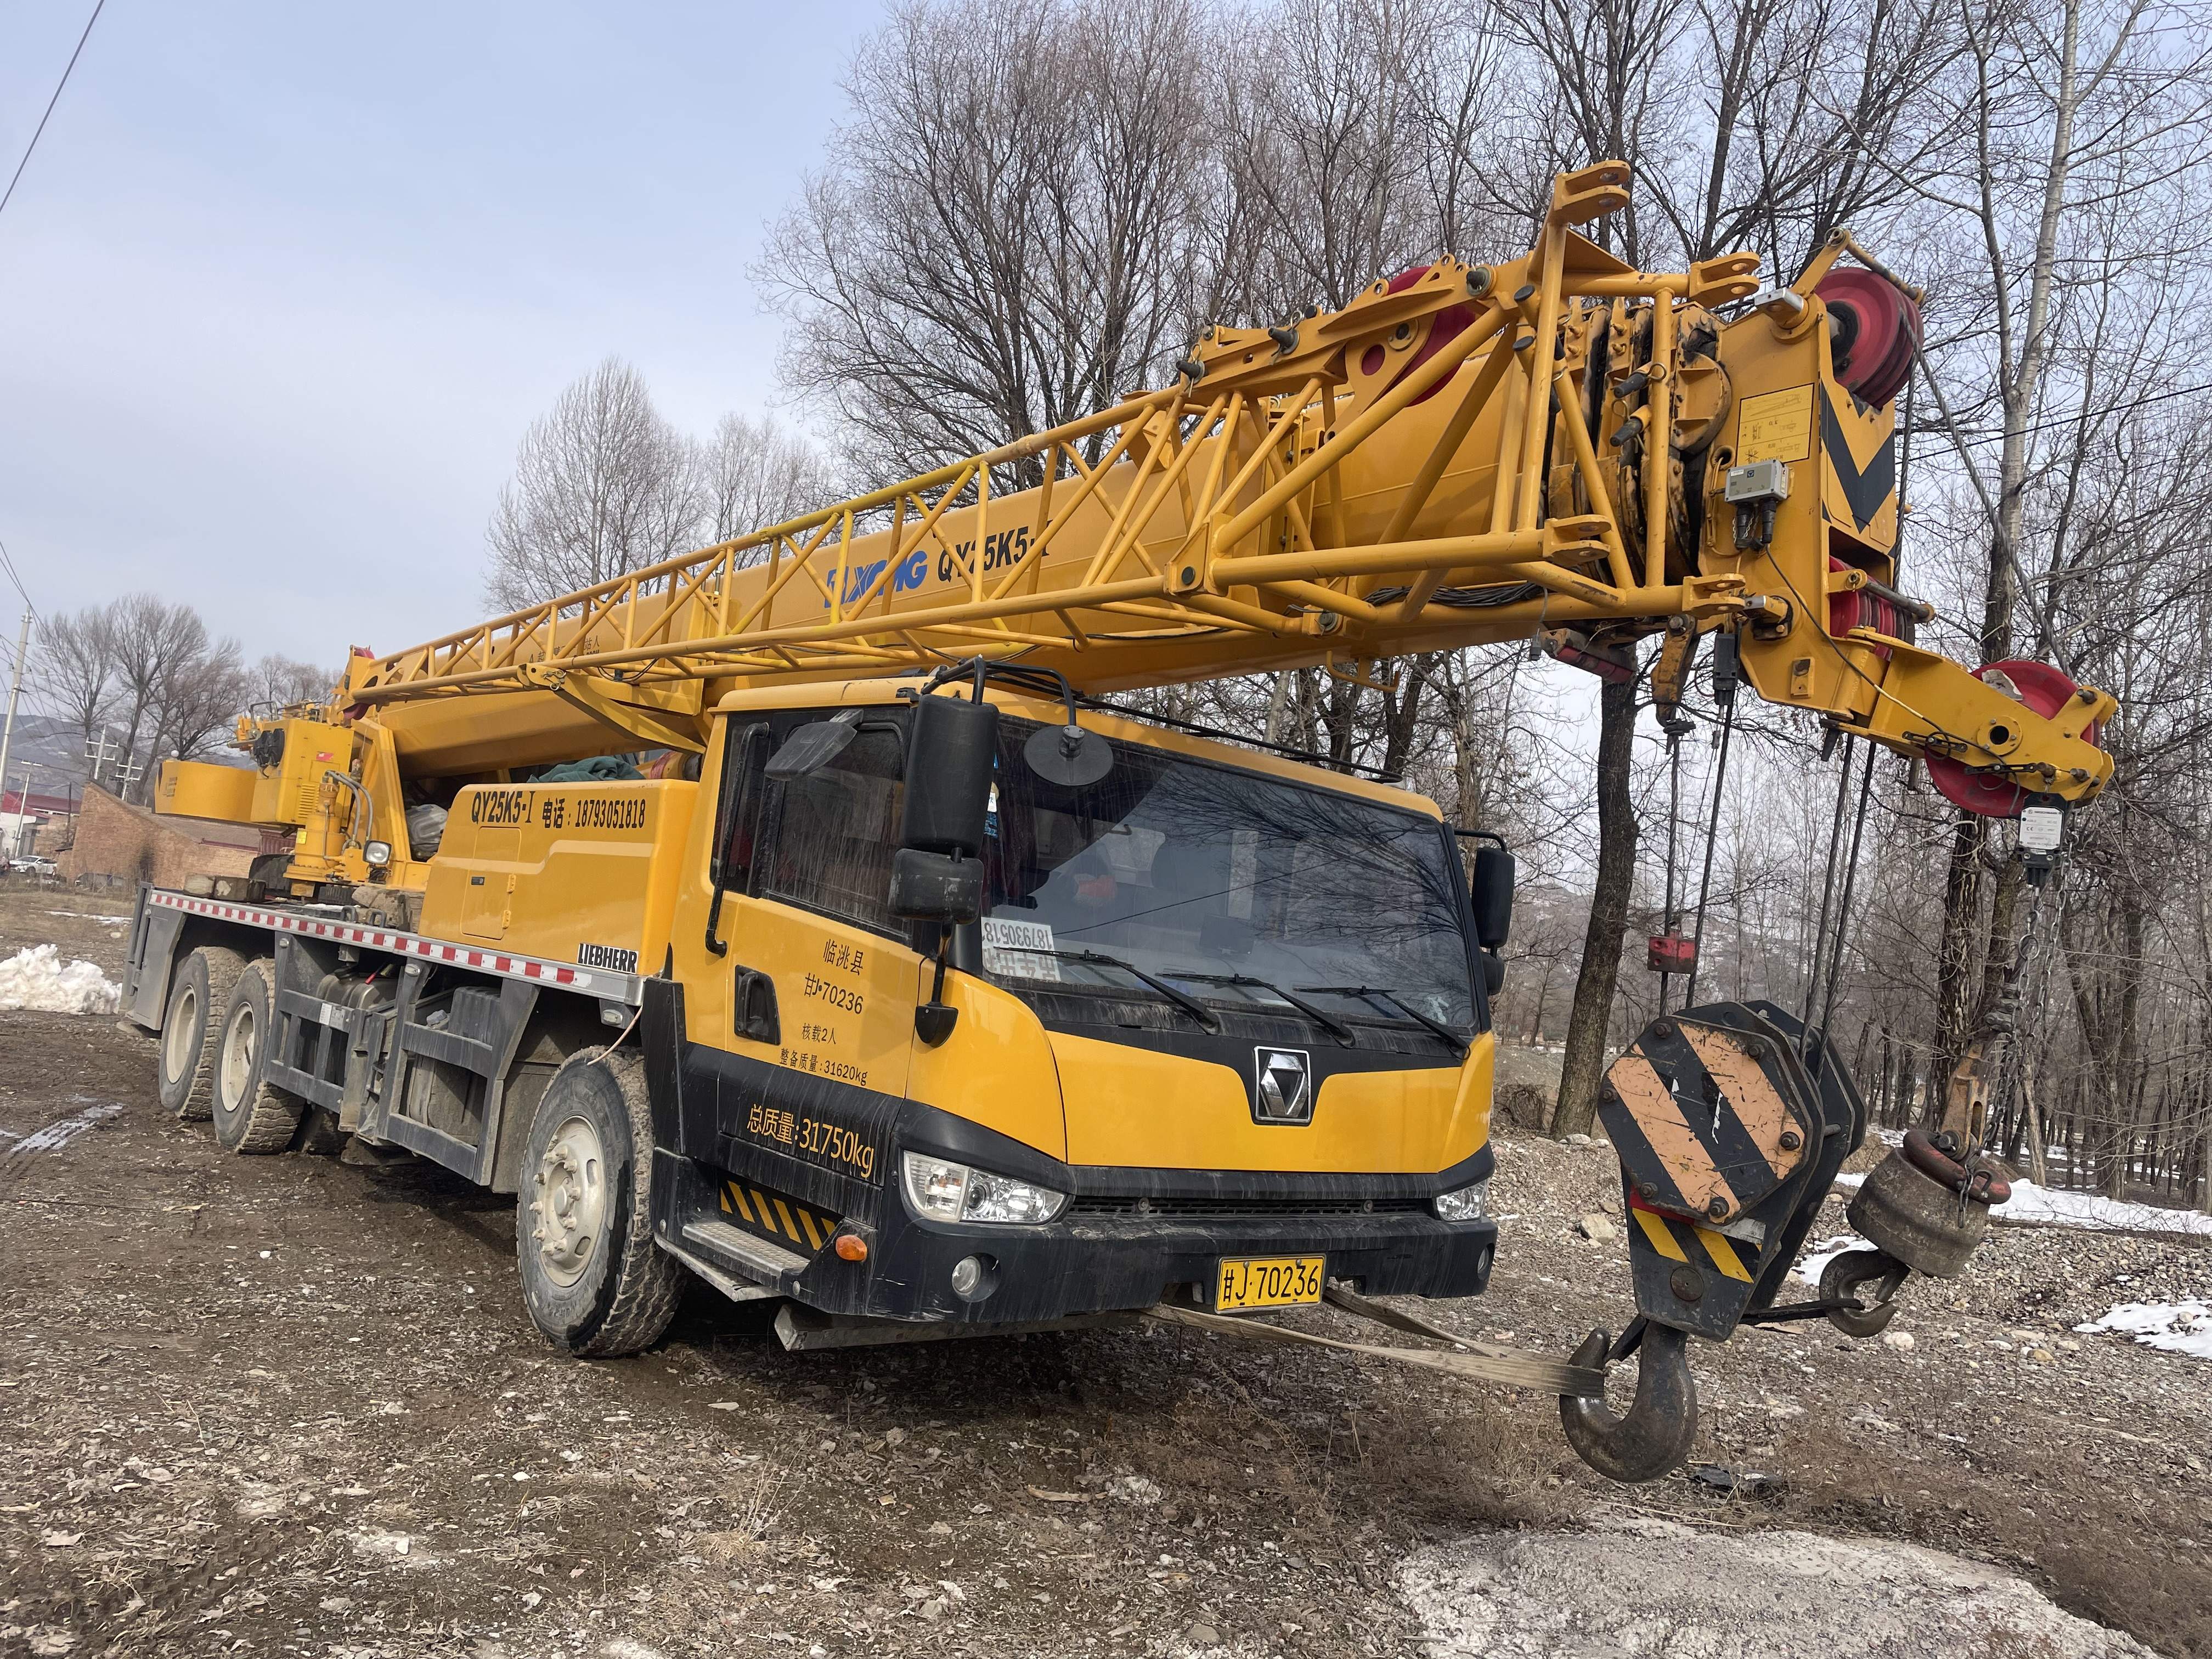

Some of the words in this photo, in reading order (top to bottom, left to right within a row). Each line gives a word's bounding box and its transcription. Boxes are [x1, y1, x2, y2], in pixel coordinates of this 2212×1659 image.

[471, 791, 535, 825] QY25K5-I
[983, 922, 1052, 950] 187930518
[578, 944, 637, 973] LIEBHERR
[823, 939, 864, 975] 临洮县
[802, 1022, 836, 1045] 核载2人
